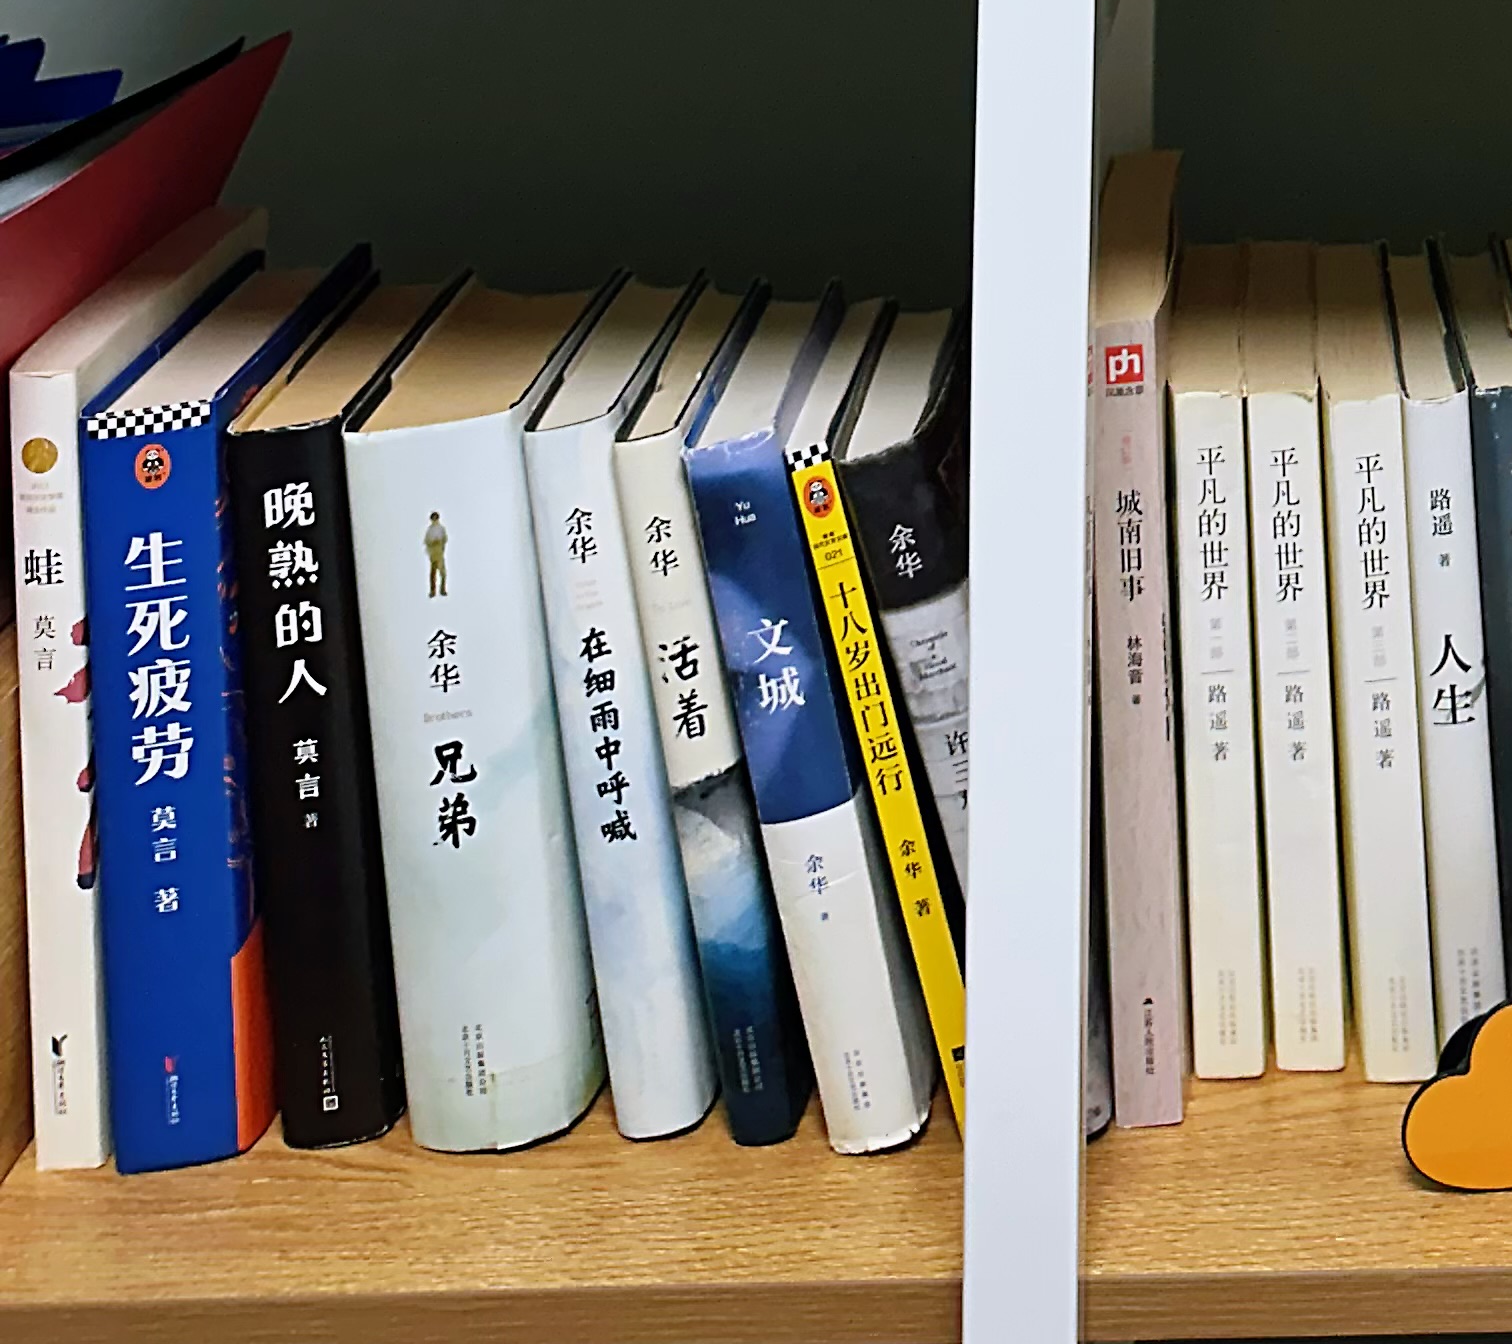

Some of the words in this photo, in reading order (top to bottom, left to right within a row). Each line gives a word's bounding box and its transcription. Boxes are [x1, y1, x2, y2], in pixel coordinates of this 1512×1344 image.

[564, 507, 599, 564] 余华
[644, 516, 680, 577] 余华
[888, 523, 924, 579] 余华
[1115, 489, 1146, 603] 城南旧事
[1196, 444, 1230, 602] 平凡的世界
[1269, 446, 1305, 604] 平凡的世界
[1354, 453, 1391, 611] 平凡的世界
[1429, 488, 1455, 537] 路遥
[24, 547, 65, 587] 蛙
[263, 480, 328, 705] 晚熟的人
[33, 615, 57, 671] 莫言
[123, 531, 195, 786] 生死疲劳
[427, 629, 461, 693] 余华
[658, 634, 709, 740] 活着
[747, 617, 806, 714] 文城
[829, 581, 903, 796] 十八岁出门远行
[1126, 634, 1144, 685] 林海音
[1429, 632, 1477, 727] 人生
[293, 737, 320, 800] 莫言
[579, 627, 638, 844] 在细雨中呼喊
[151, 804, 178, 863] 莫言
[430, 740, 478, 849] 兄弟
[153, 886, 180, 914] 著
